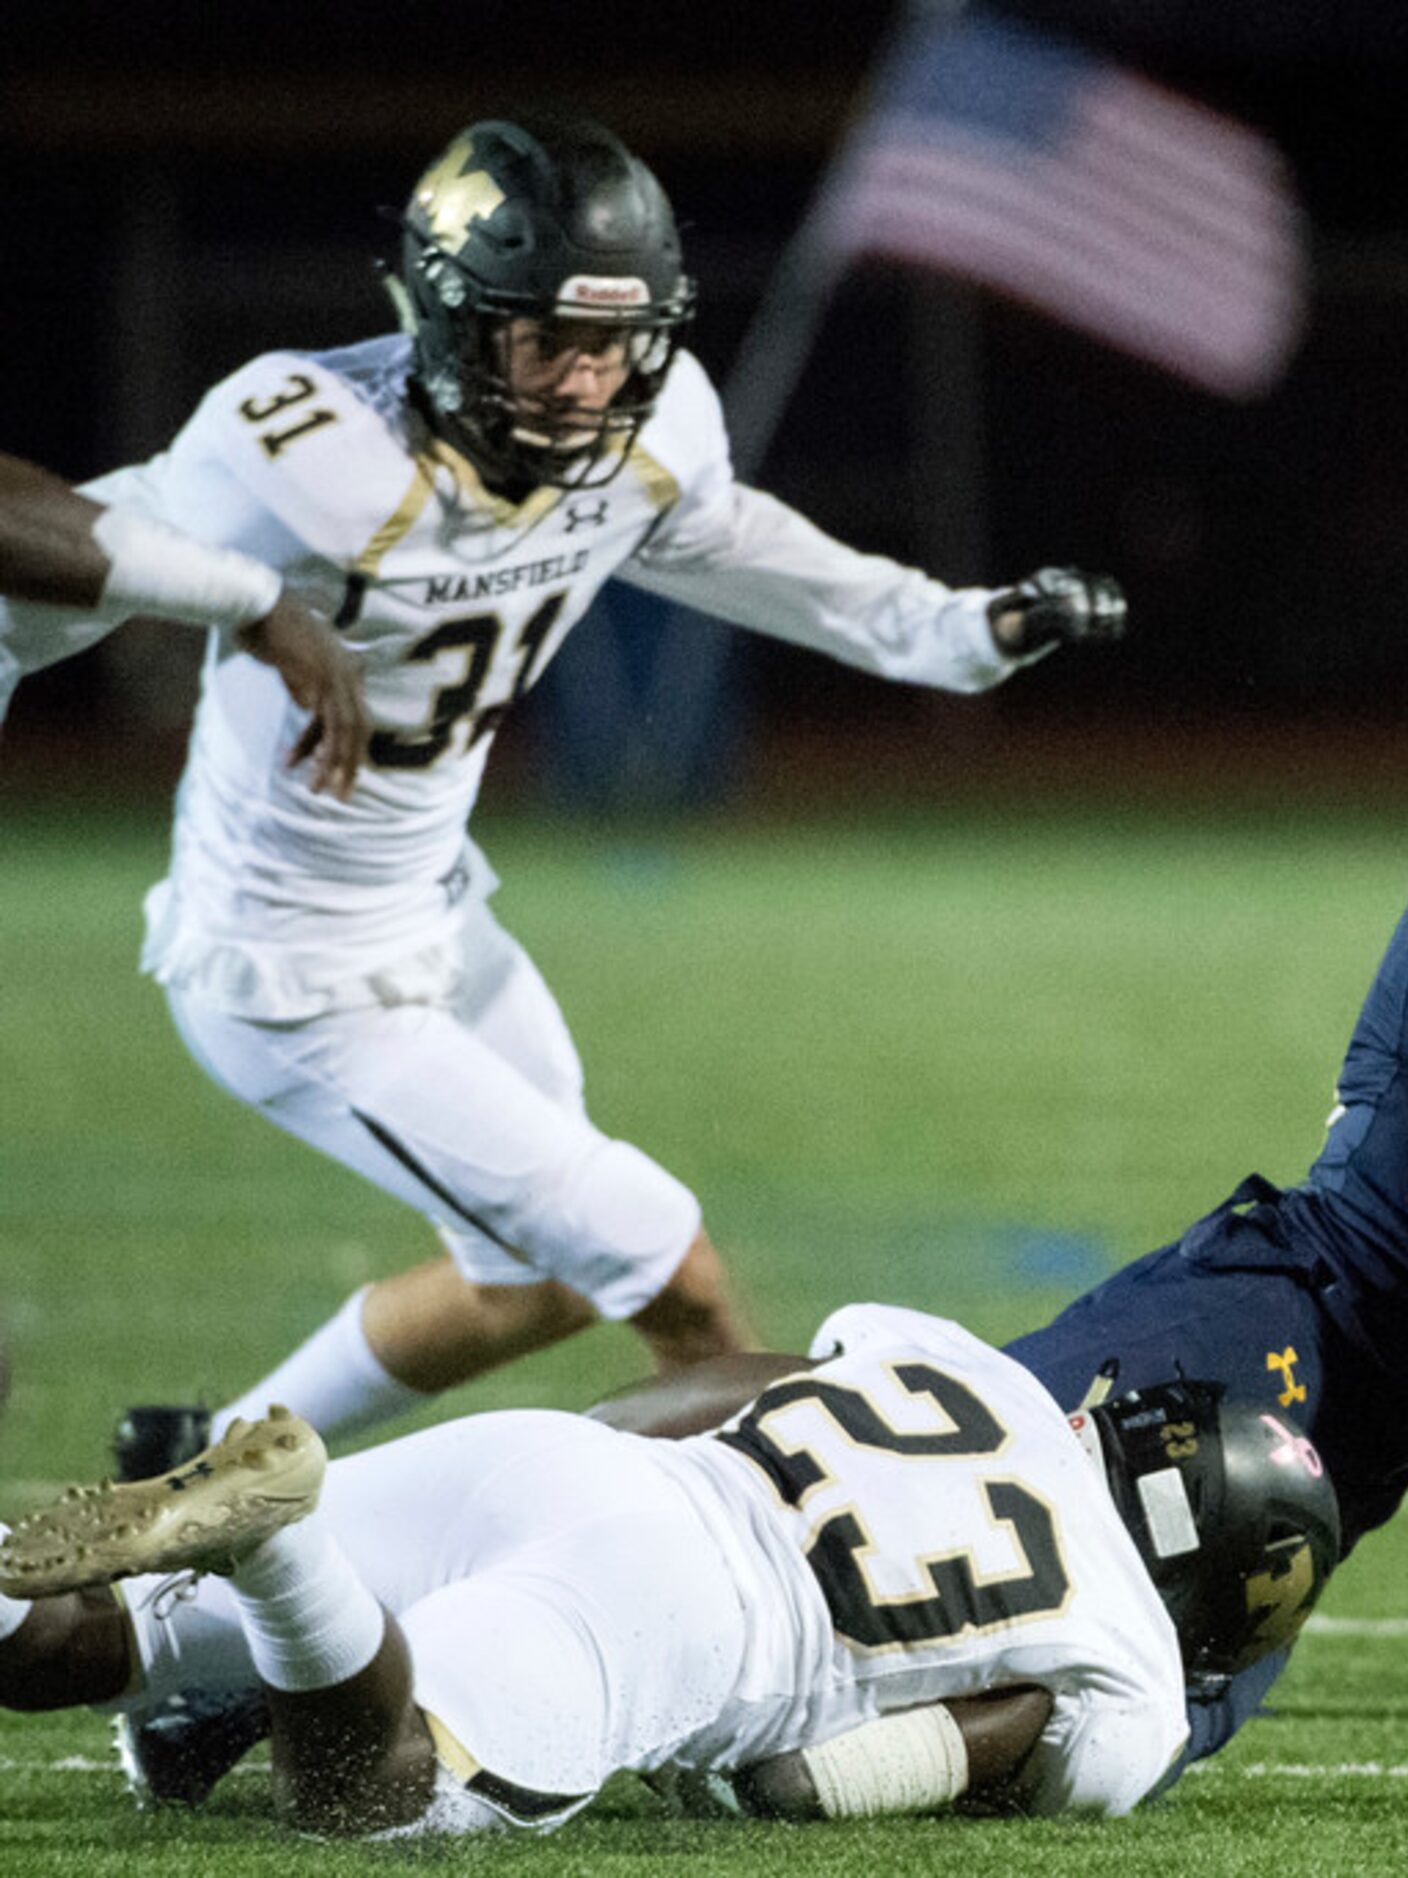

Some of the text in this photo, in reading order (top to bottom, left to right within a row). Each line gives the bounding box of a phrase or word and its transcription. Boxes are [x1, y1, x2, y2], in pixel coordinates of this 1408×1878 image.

[238, 373, 340, 460] 31
[424, 549, 592, 605] MANSFIELD
[366, 589, 570, 772] 31
[1160, 1420, 1200, 1459] 23
[720, 1361, 1077, 1656] 23
